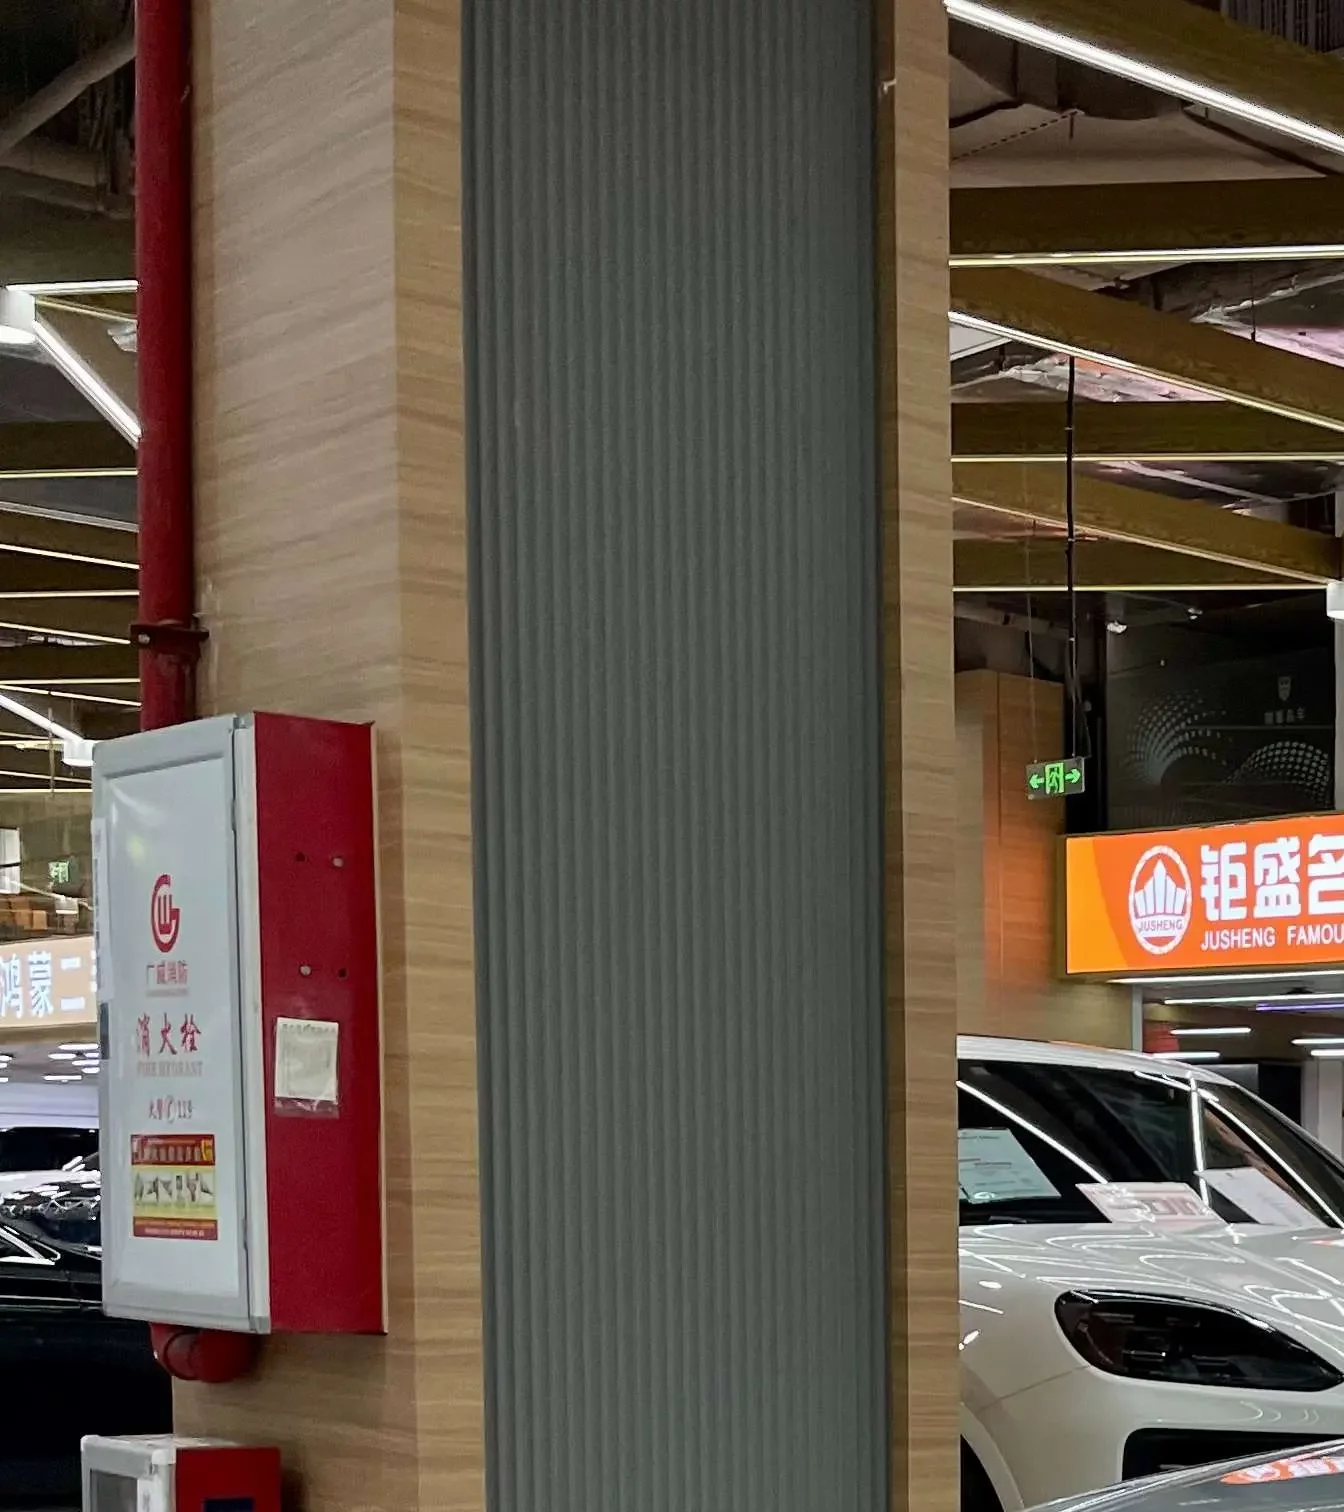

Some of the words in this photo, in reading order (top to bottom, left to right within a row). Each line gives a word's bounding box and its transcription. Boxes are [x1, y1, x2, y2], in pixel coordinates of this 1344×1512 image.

[1138, 918, 1184, 933] JUSHENG
[1201, 926, 1276, 951] JUSHENG
[0, 950, 97, 1018] 鸿蒙二
[136, 1012, 202, 1057] 消火栓
